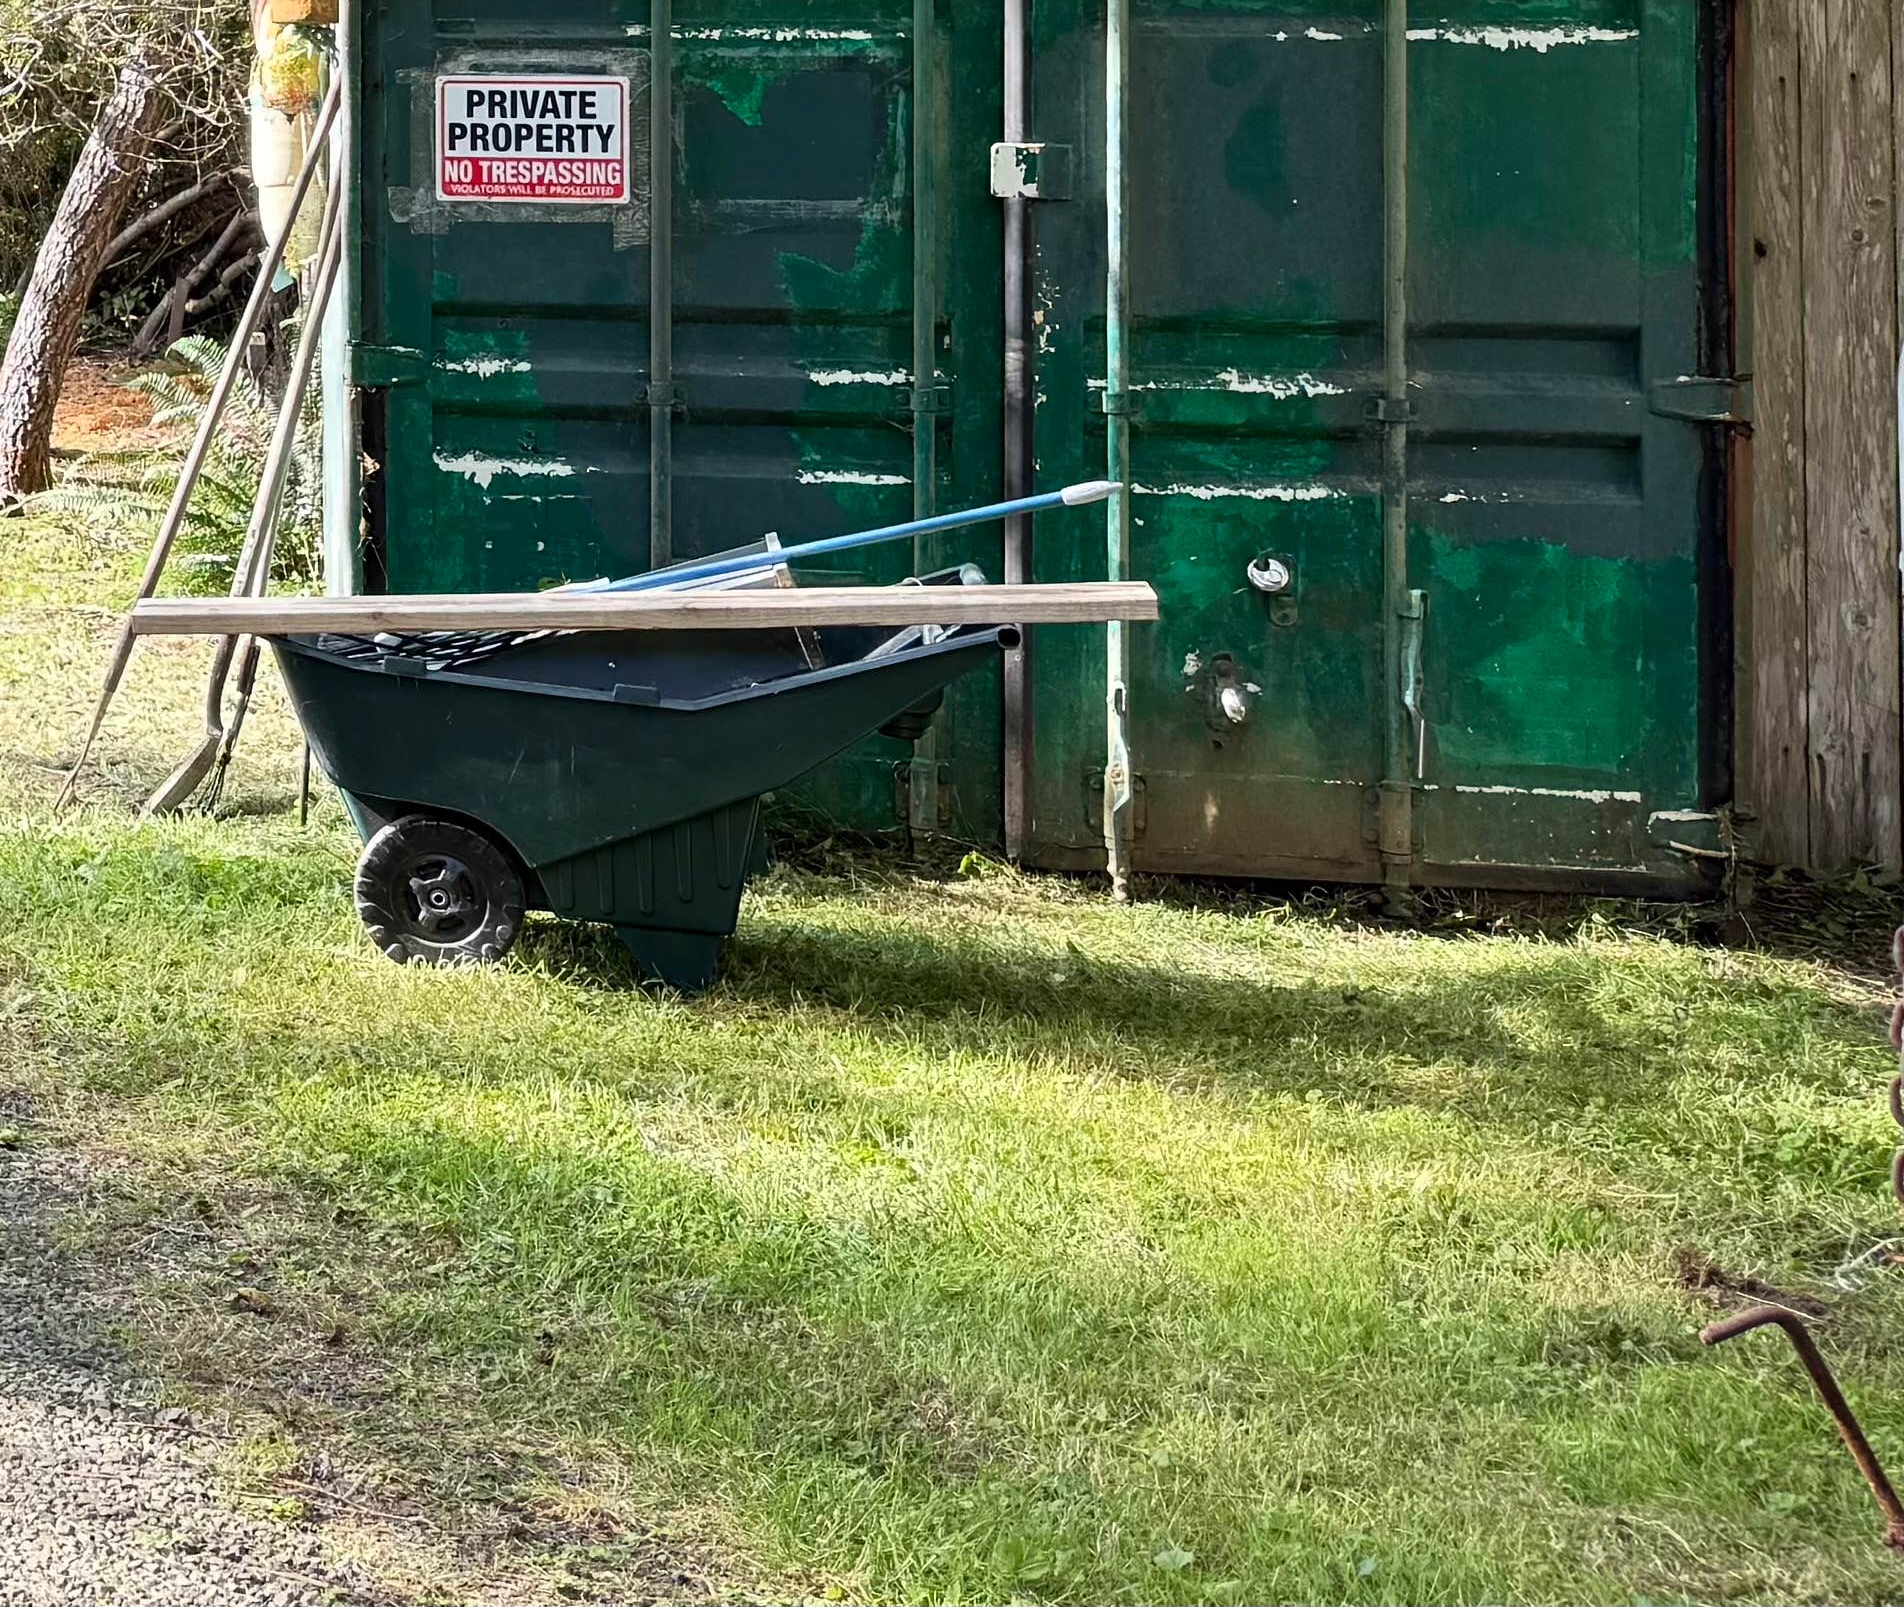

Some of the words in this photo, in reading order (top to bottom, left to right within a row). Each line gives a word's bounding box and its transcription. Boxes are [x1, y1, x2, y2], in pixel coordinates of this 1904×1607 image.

[466, 89, 597, 119] PRIVATE
[448, 122, 615, 153] PROPERTY
[444, 160, 473, 183] NO
[478, 160, 621, 185] TRESPASSING
[450, 184, 506, 195] VIOLATORS
[507, 185, 532, 195] WILL
[549, 185, 614, 197] PROSECUTED
